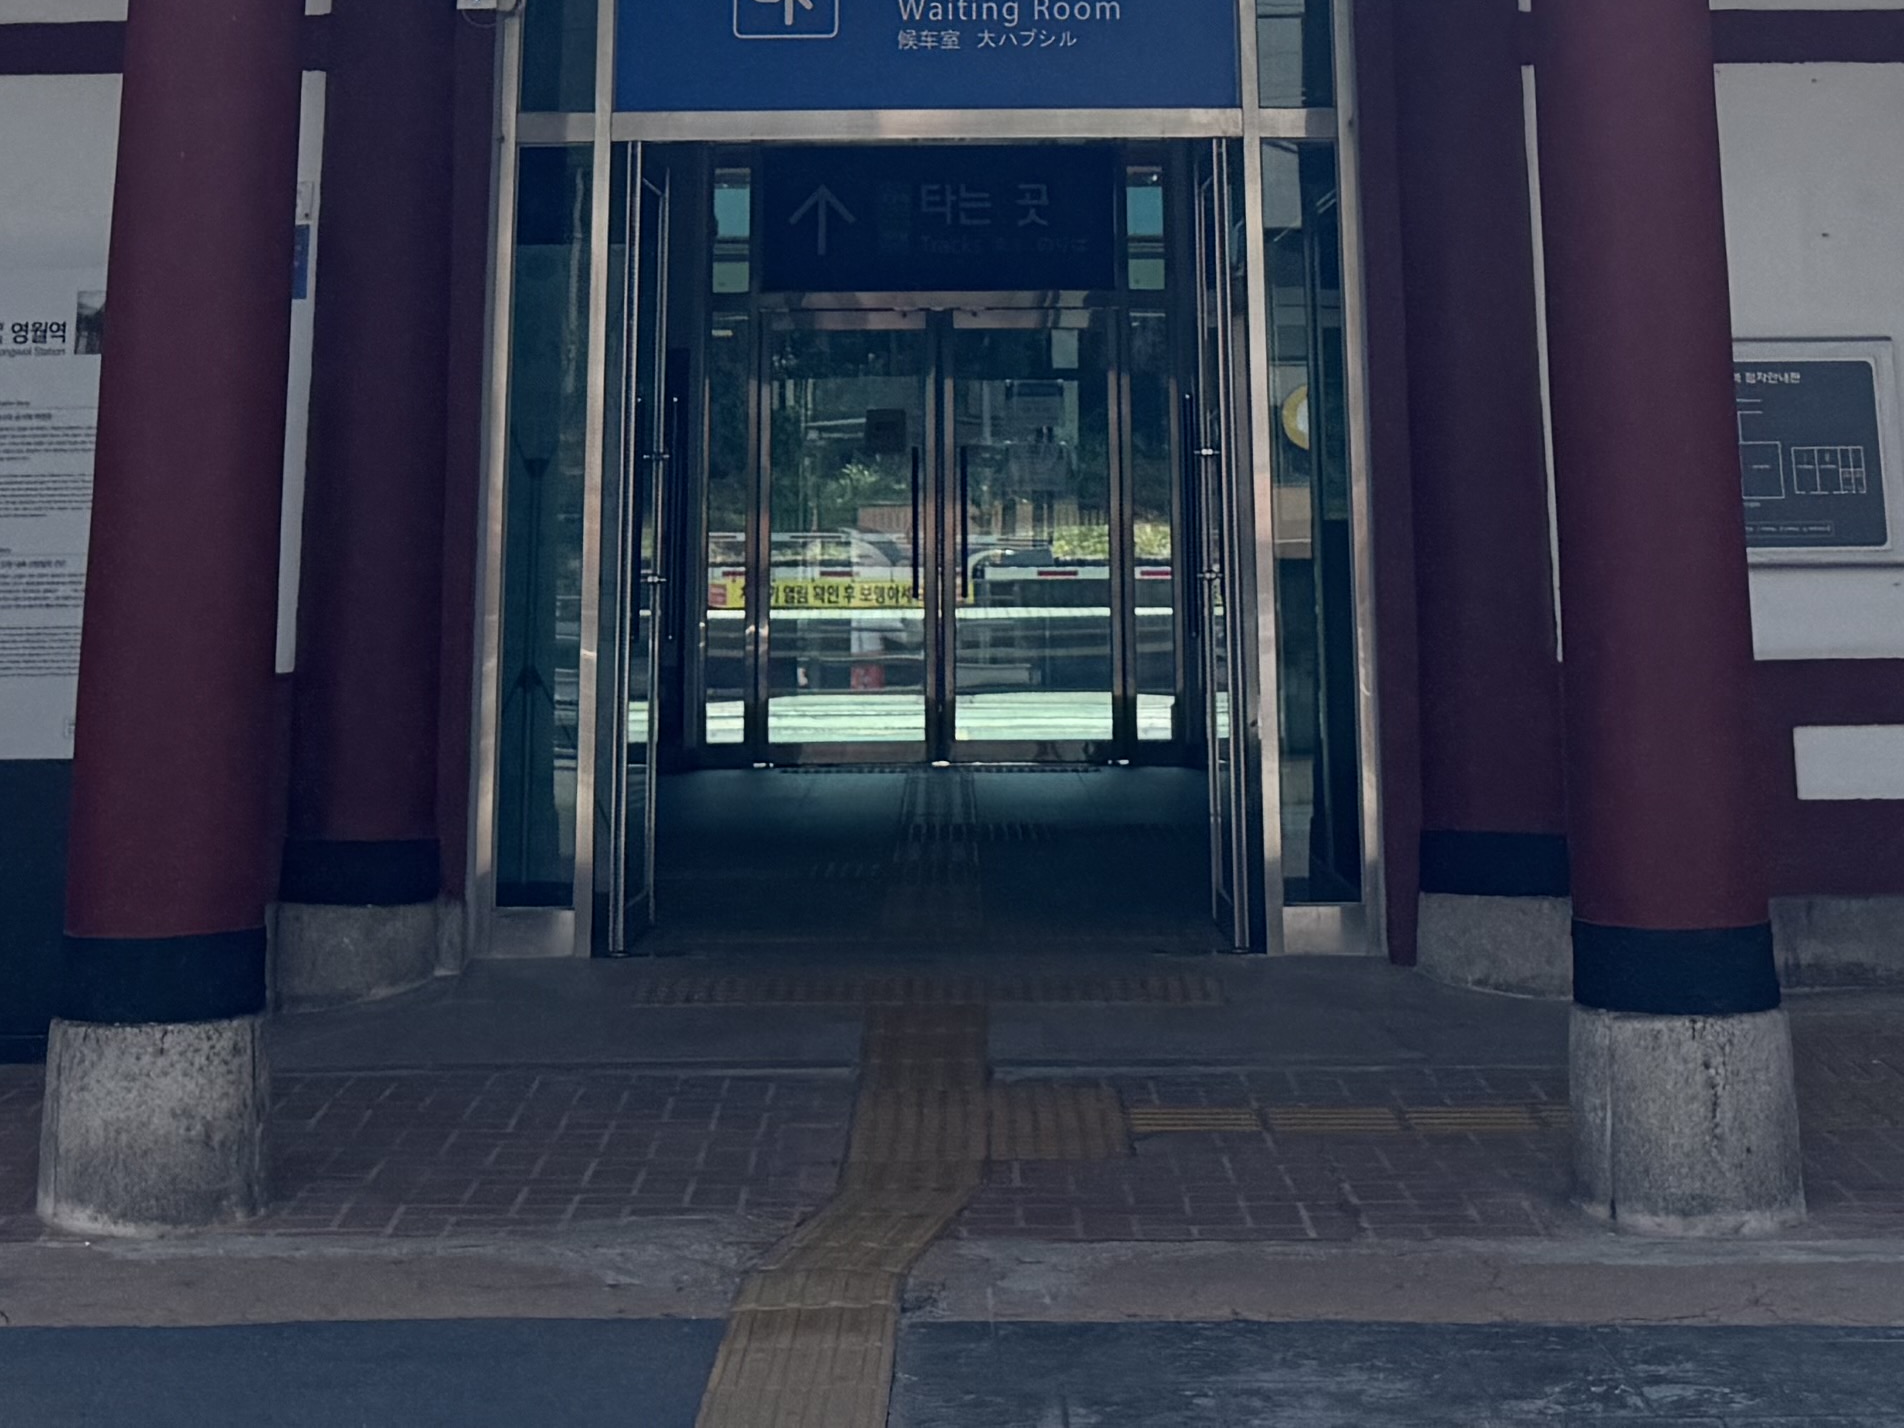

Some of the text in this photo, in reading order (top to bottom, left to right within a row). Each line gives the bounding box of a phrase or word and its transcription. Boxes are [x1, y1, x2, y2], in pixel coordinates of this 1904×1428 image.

[897, 29, 961, 50] 候车室
[920, 182, 1050, 227] 타는 곳
[11, 320, 67, 344] 영월역
[844, 583, 856, 604] 후
